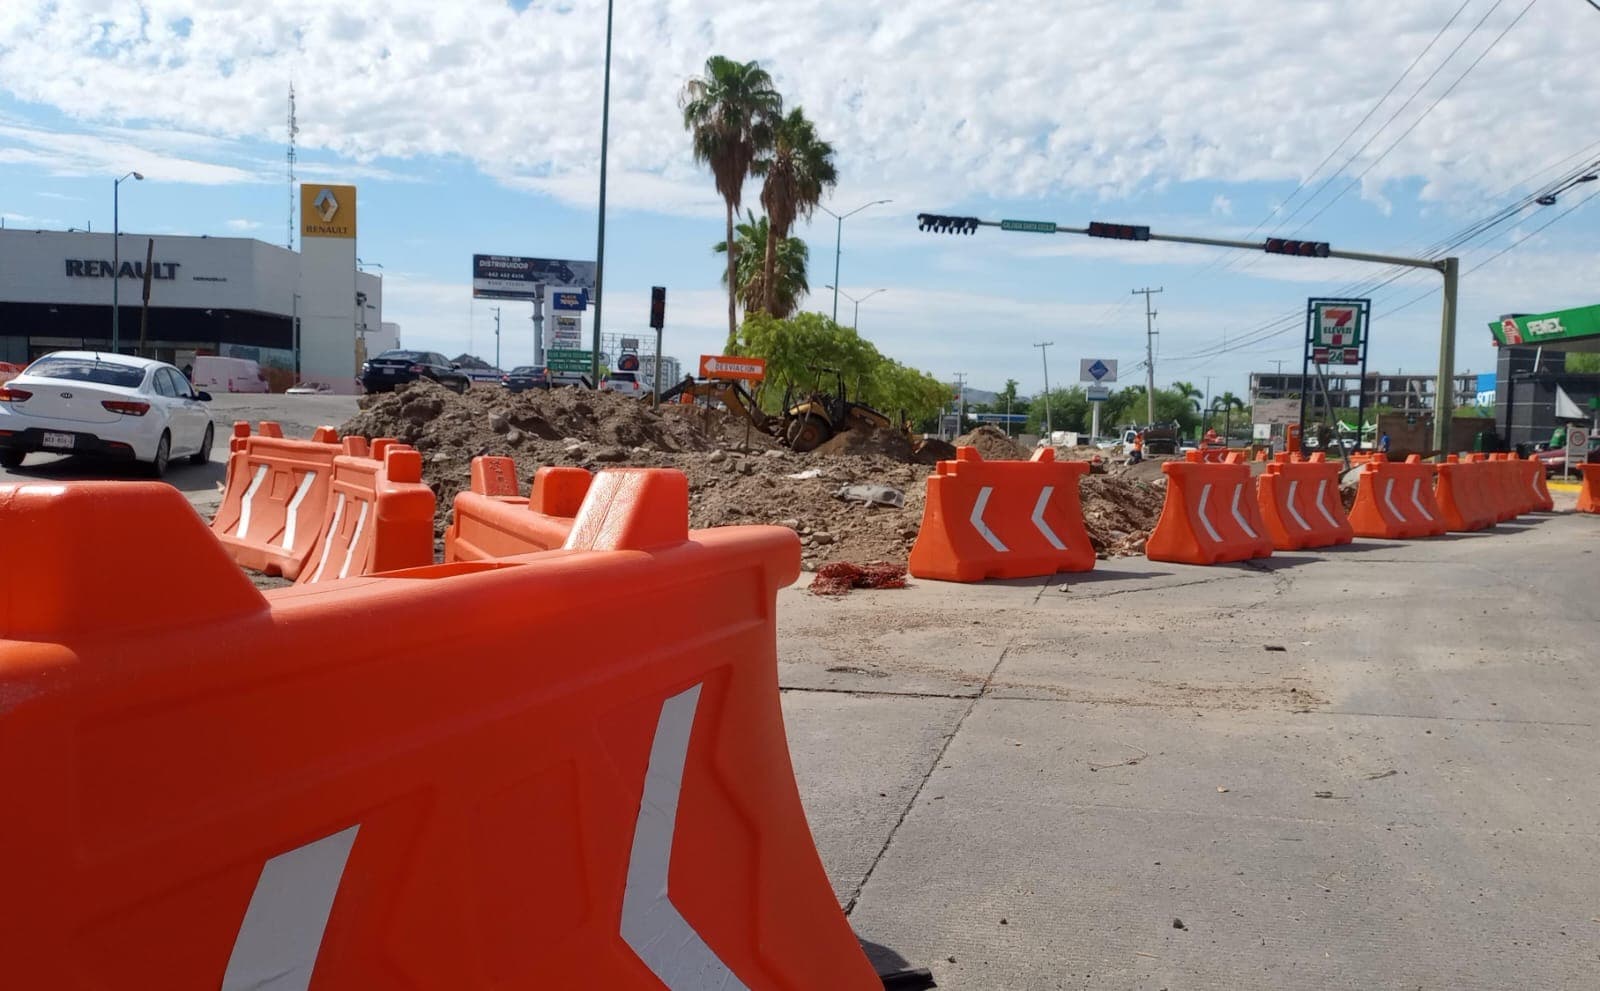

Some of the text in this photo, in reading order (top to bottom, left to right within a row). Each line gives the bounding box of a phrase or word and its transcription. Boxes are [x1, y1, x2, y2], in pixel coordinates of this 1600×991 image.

[306, 225, 348, 234] RENAULT
[65, 259, 180, 280] RENAULT
[1325, 309, 1353, 346] 7
[1329, 350, 1343, 362] 24
